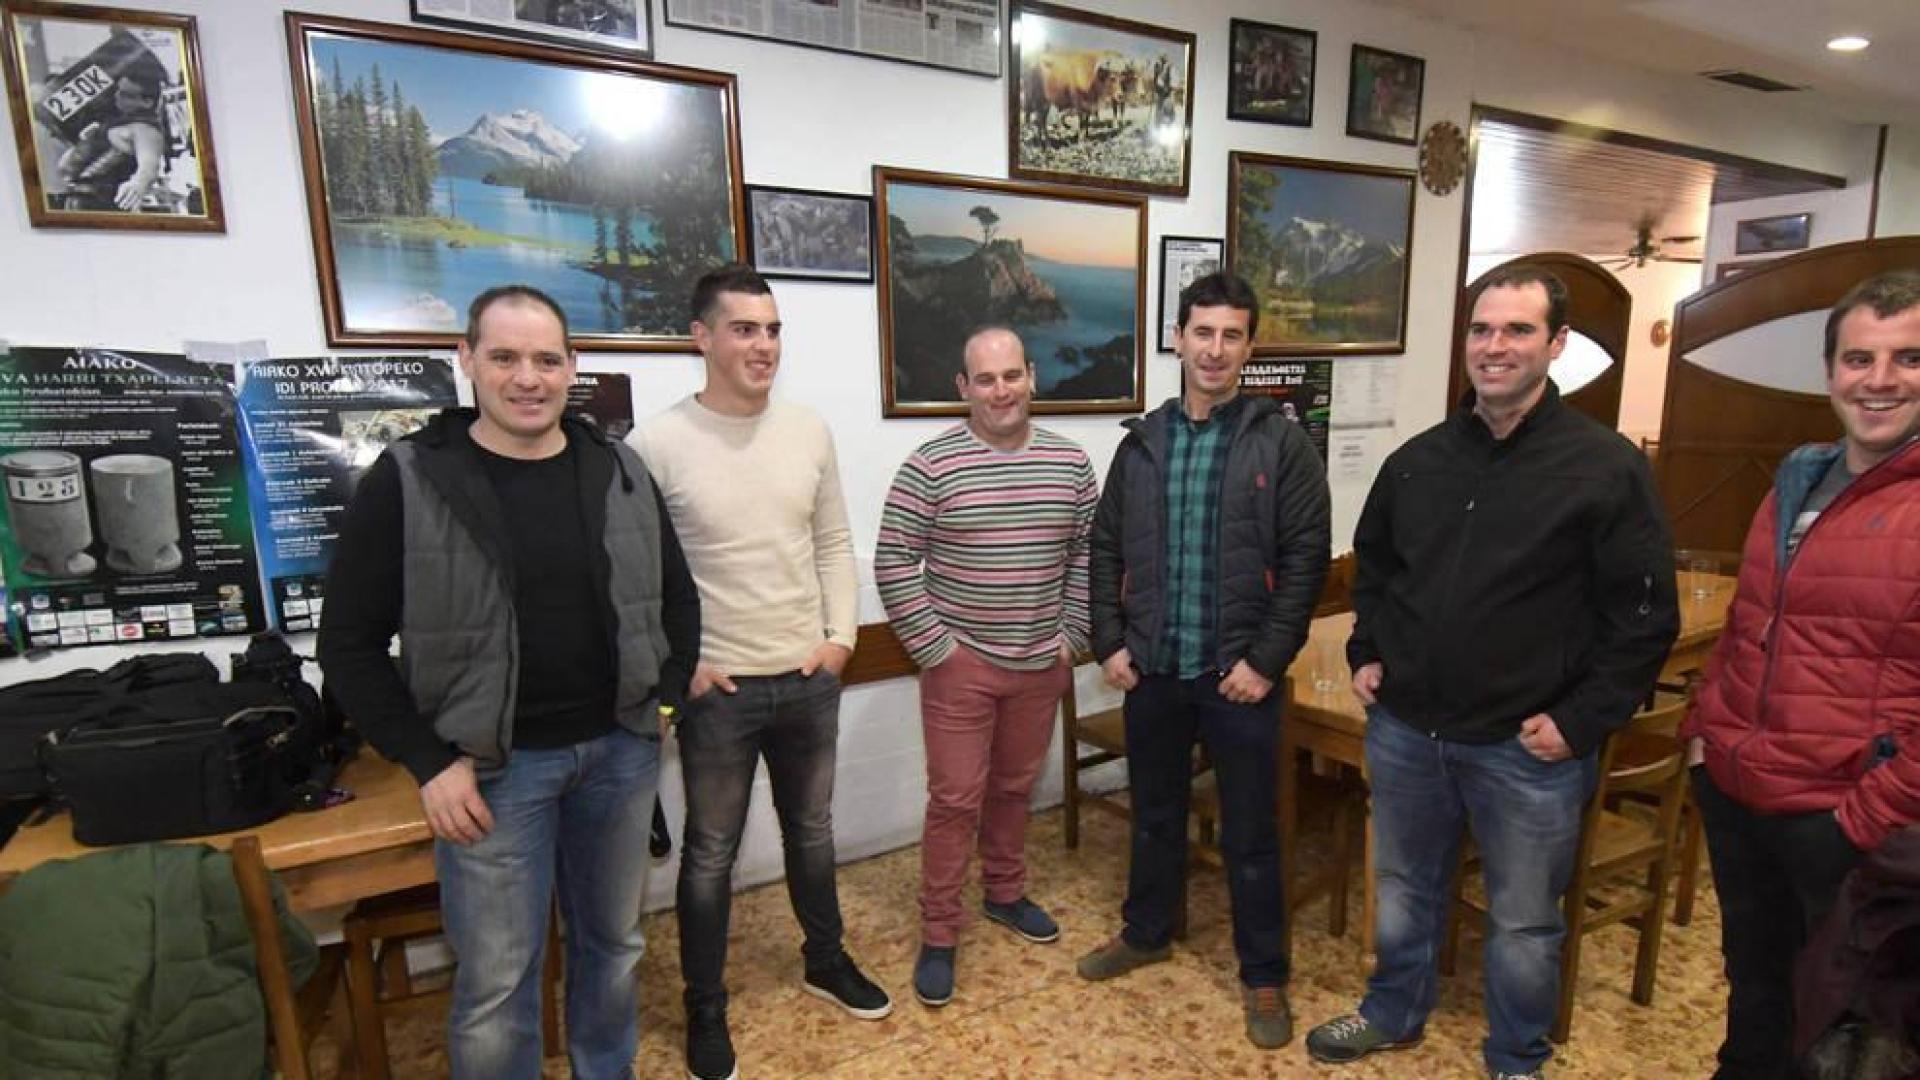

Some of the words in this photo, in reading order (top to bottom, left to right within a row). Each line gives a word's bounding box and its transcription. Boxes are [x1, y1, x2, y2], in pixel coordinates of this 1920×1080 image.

[48, 69, 109, 116] 230K
[63, 356, 137, 369] AIAKO
[18, 478, 75, 498] 125
